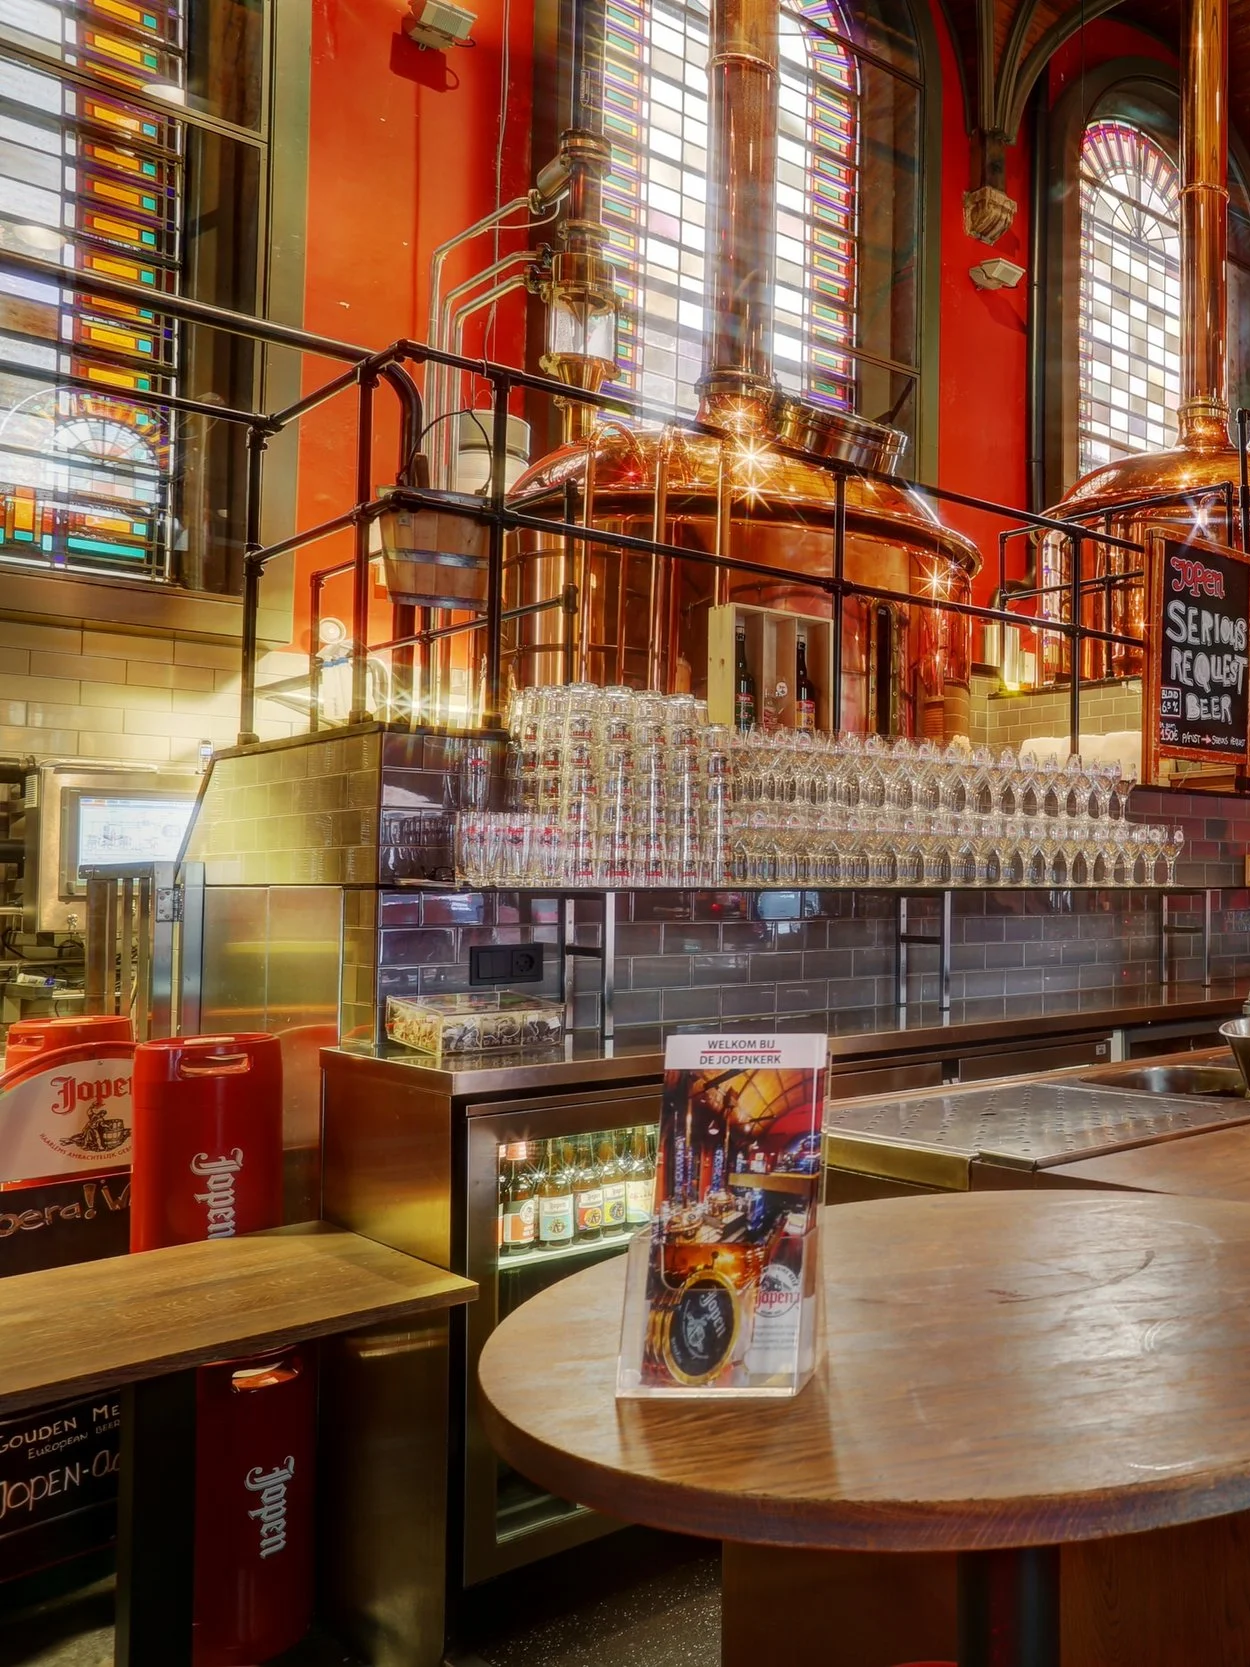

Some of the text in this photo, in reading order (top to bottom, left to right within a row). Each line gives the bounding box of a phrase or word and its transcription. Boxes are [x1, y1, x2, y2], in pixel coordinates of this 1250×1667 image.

[1165, 600, 1248, 652] SERIOUS
[1170, 646, 1249, 695] REQUEST
[1185, 692, 1233, 725] BEER
[699, 1054, 782, 1066] DE JOPENKERK
[707, 1039, 775, 1050] WELKOM BIJ
[50, 1075, 132, 1116] Jope
[28, 1432, 88, 1460] EUROPEAN
[244, 1455, 295, 1559] Jopen
